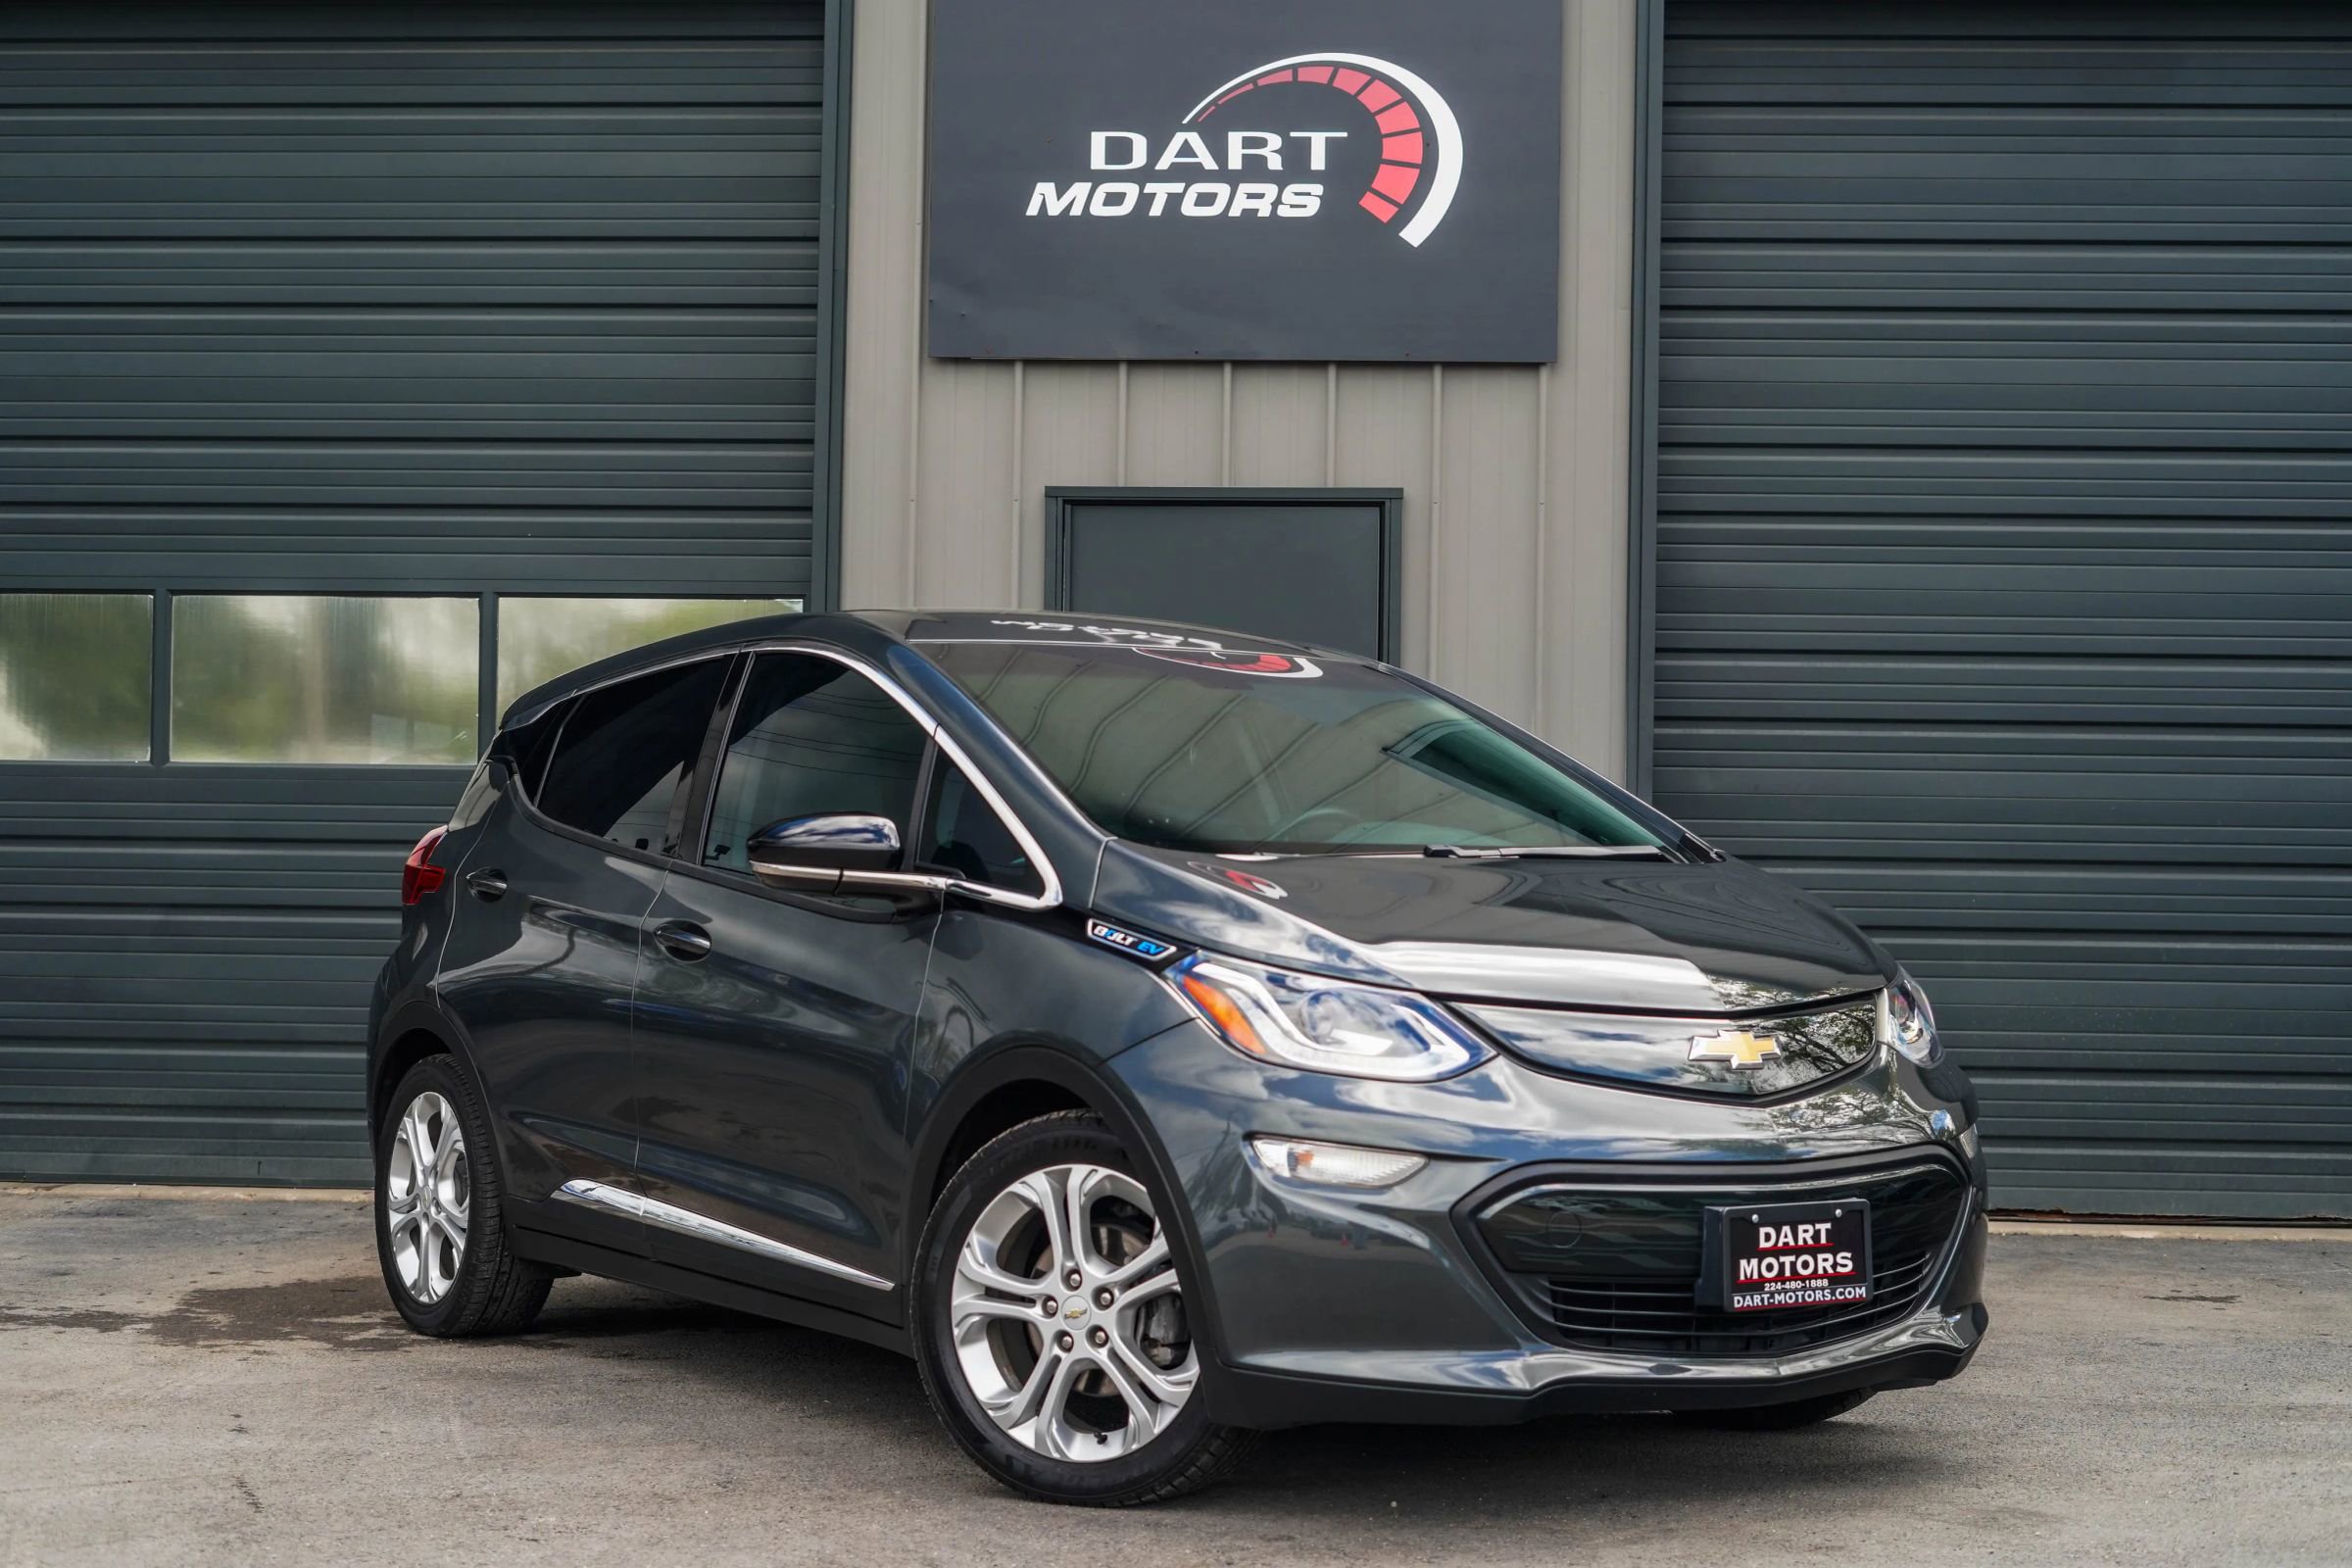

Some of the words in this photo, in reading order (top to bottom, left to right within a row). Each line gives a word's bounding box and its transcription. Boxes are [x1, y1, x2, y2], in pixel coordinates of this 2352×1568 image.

[1090, 131, 1348, 171] DART
[1025, 182, 1324, 218] MOTORS
[1094, 926, 1137, 945] BOLT
[1138, 941, 1163, 954] EV
[1759, 1223, 1831, 1248] DART
[1740, 1252, 1852, 1280] MOTORS
[1734, 1287, 1866, 1307] DART-MOTORS.COM
[1764, 1279, 1829, 1292] 224-480-1888
